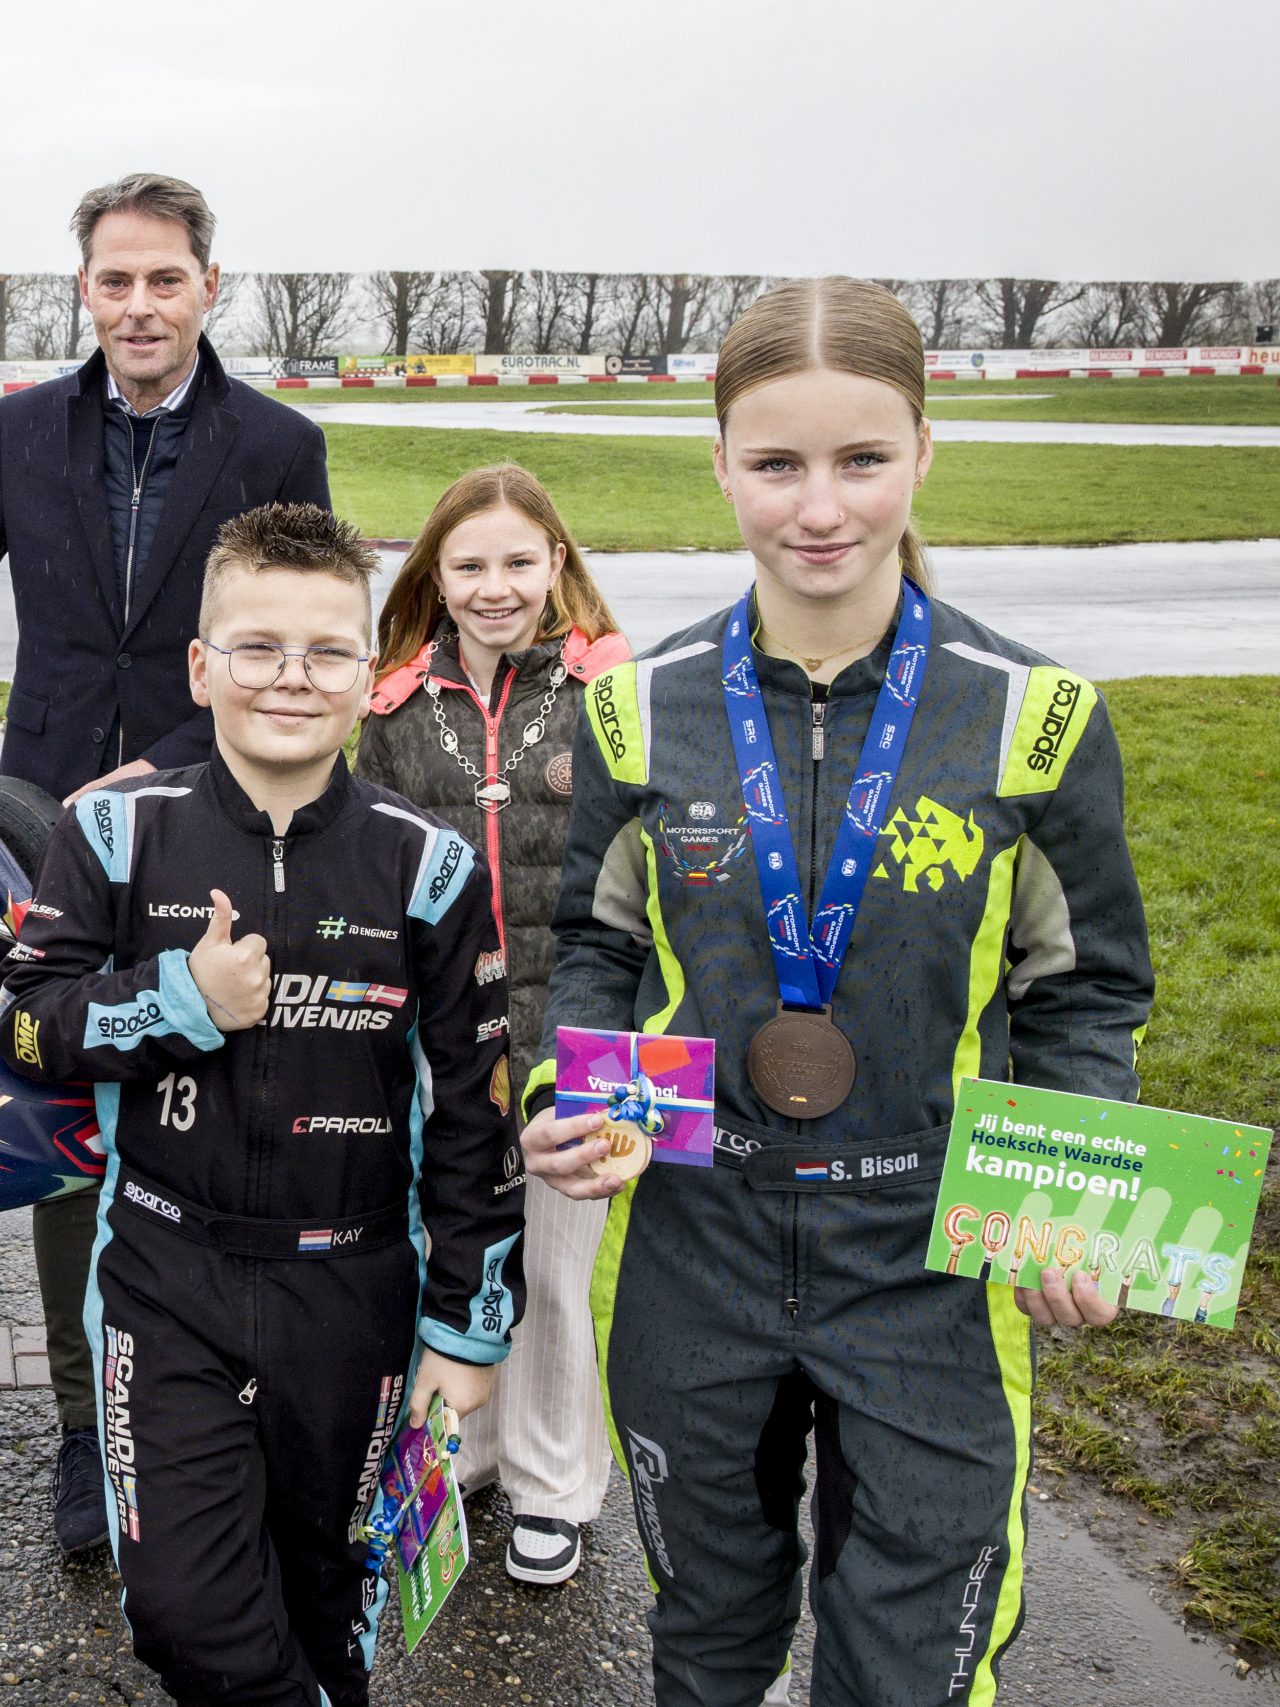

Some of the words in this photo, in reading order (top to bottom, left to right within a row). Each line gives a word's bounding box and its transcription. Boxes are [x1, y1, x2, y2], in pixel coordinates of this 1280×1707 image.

[299, 361, 336, 370] FRAME
[900, 660, 912, 685] GAMES
[903, 651, 919, 698] MOTORSPORT
[592, 675, 626, 764] sparco
[745, 719, 757, 744] SRO
[883, 725, 896, 750] SRO
[1027, 679, 1081, 775] sparco
[757, 782, 768, 808] GAMES
[761, 770, 776, 818] MOTORSPORT
[863, 788, 874, 815] GAMES
[866, 779, 884, 828] MOTORSPORT
[666, 827, 741, 835] MOTORSPORT
[680, 835, 719, 843] GAMES
[429, 840, 464, 903] sparco
[783, 914, 793, 941] GAMES
[786, 902, 801, 952] MOTORSPORT
[824, 920, 837, 947] GAMES
[827, 911, 846, 959] MOTORSPORT
[16, 1010, 41, 1065] OMP
[156, 1071, 198, 1132] 13
[971, 1129, 1059, 1159] Hoeksche
[1064, 1145, 1144, 1173] Waardse
[974, 1113, 999, 1131] Jij
[1002, 1116, 1046, 1140] bent
[1051, 1124, 1087, 1146] een
[1090, 1131, 1147, 1157] echte
[830, 1160, 853, 1181] S.
[861, 1152, 919, 1179] Bison
[965, 1145, 1141, 1202] kampioen!
[123, 1181, 182, 1223] sparco
[332, 1227, 363, 1246] KAY
[943, 1203, 1235, 1295] CONGRATS
[113, 1330, 137, 1477] SCANDI
[106, 1390, 128, 1535] SOUVENIRS
[348, 1429, 386, 1545] SCANDI
[624, 1424, 675, 1578] REYNOORD
[948, 1546, 1000, 1697] THUNDER
